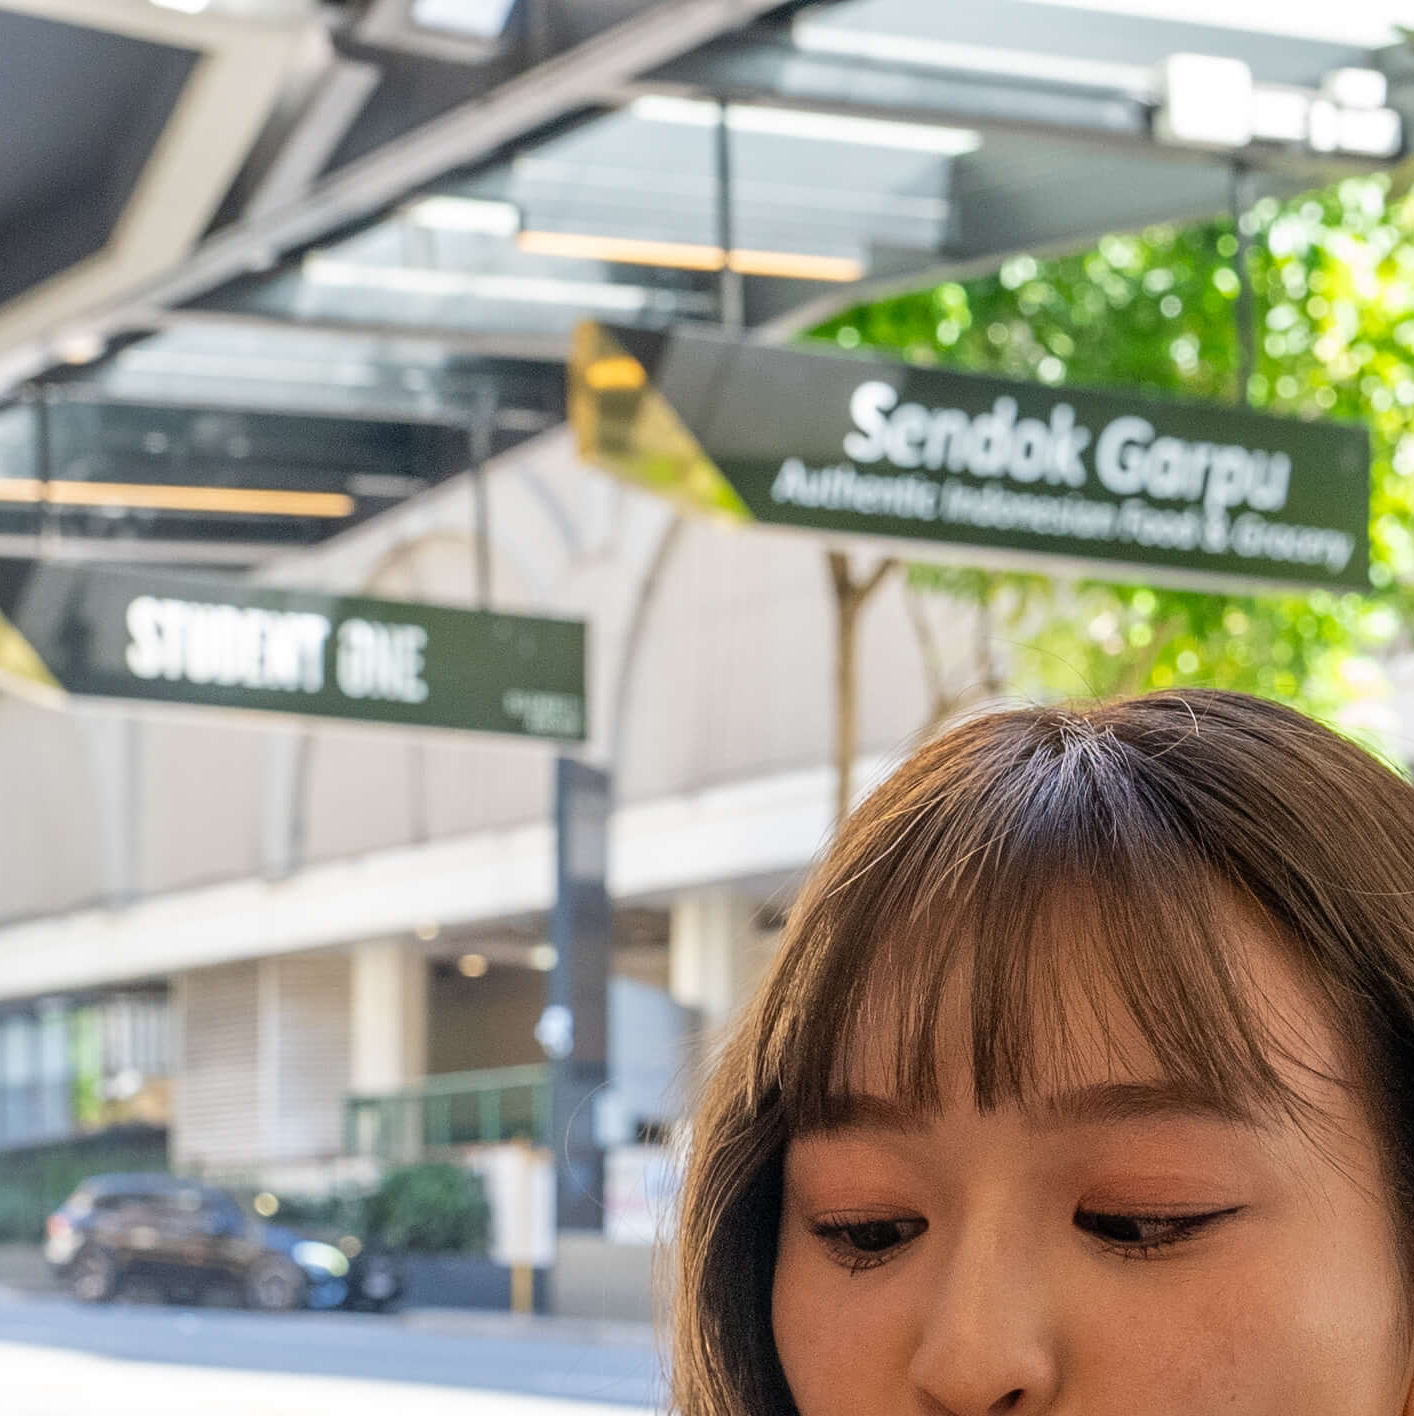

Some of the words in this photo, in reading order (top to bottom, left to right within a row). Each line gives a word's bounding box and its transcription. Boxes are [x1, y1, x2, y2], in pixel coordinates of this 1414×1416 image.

[770, 456, 938, 523] Authentic
[940, 480, 1117, 538] Indonesian
[843, 380, 1091, 488] Sendok
[1095, 415, 1292, 514] Garpu
[125, 595, 331, 694] STUDENT
[335, 618, 429, 703] ONE
